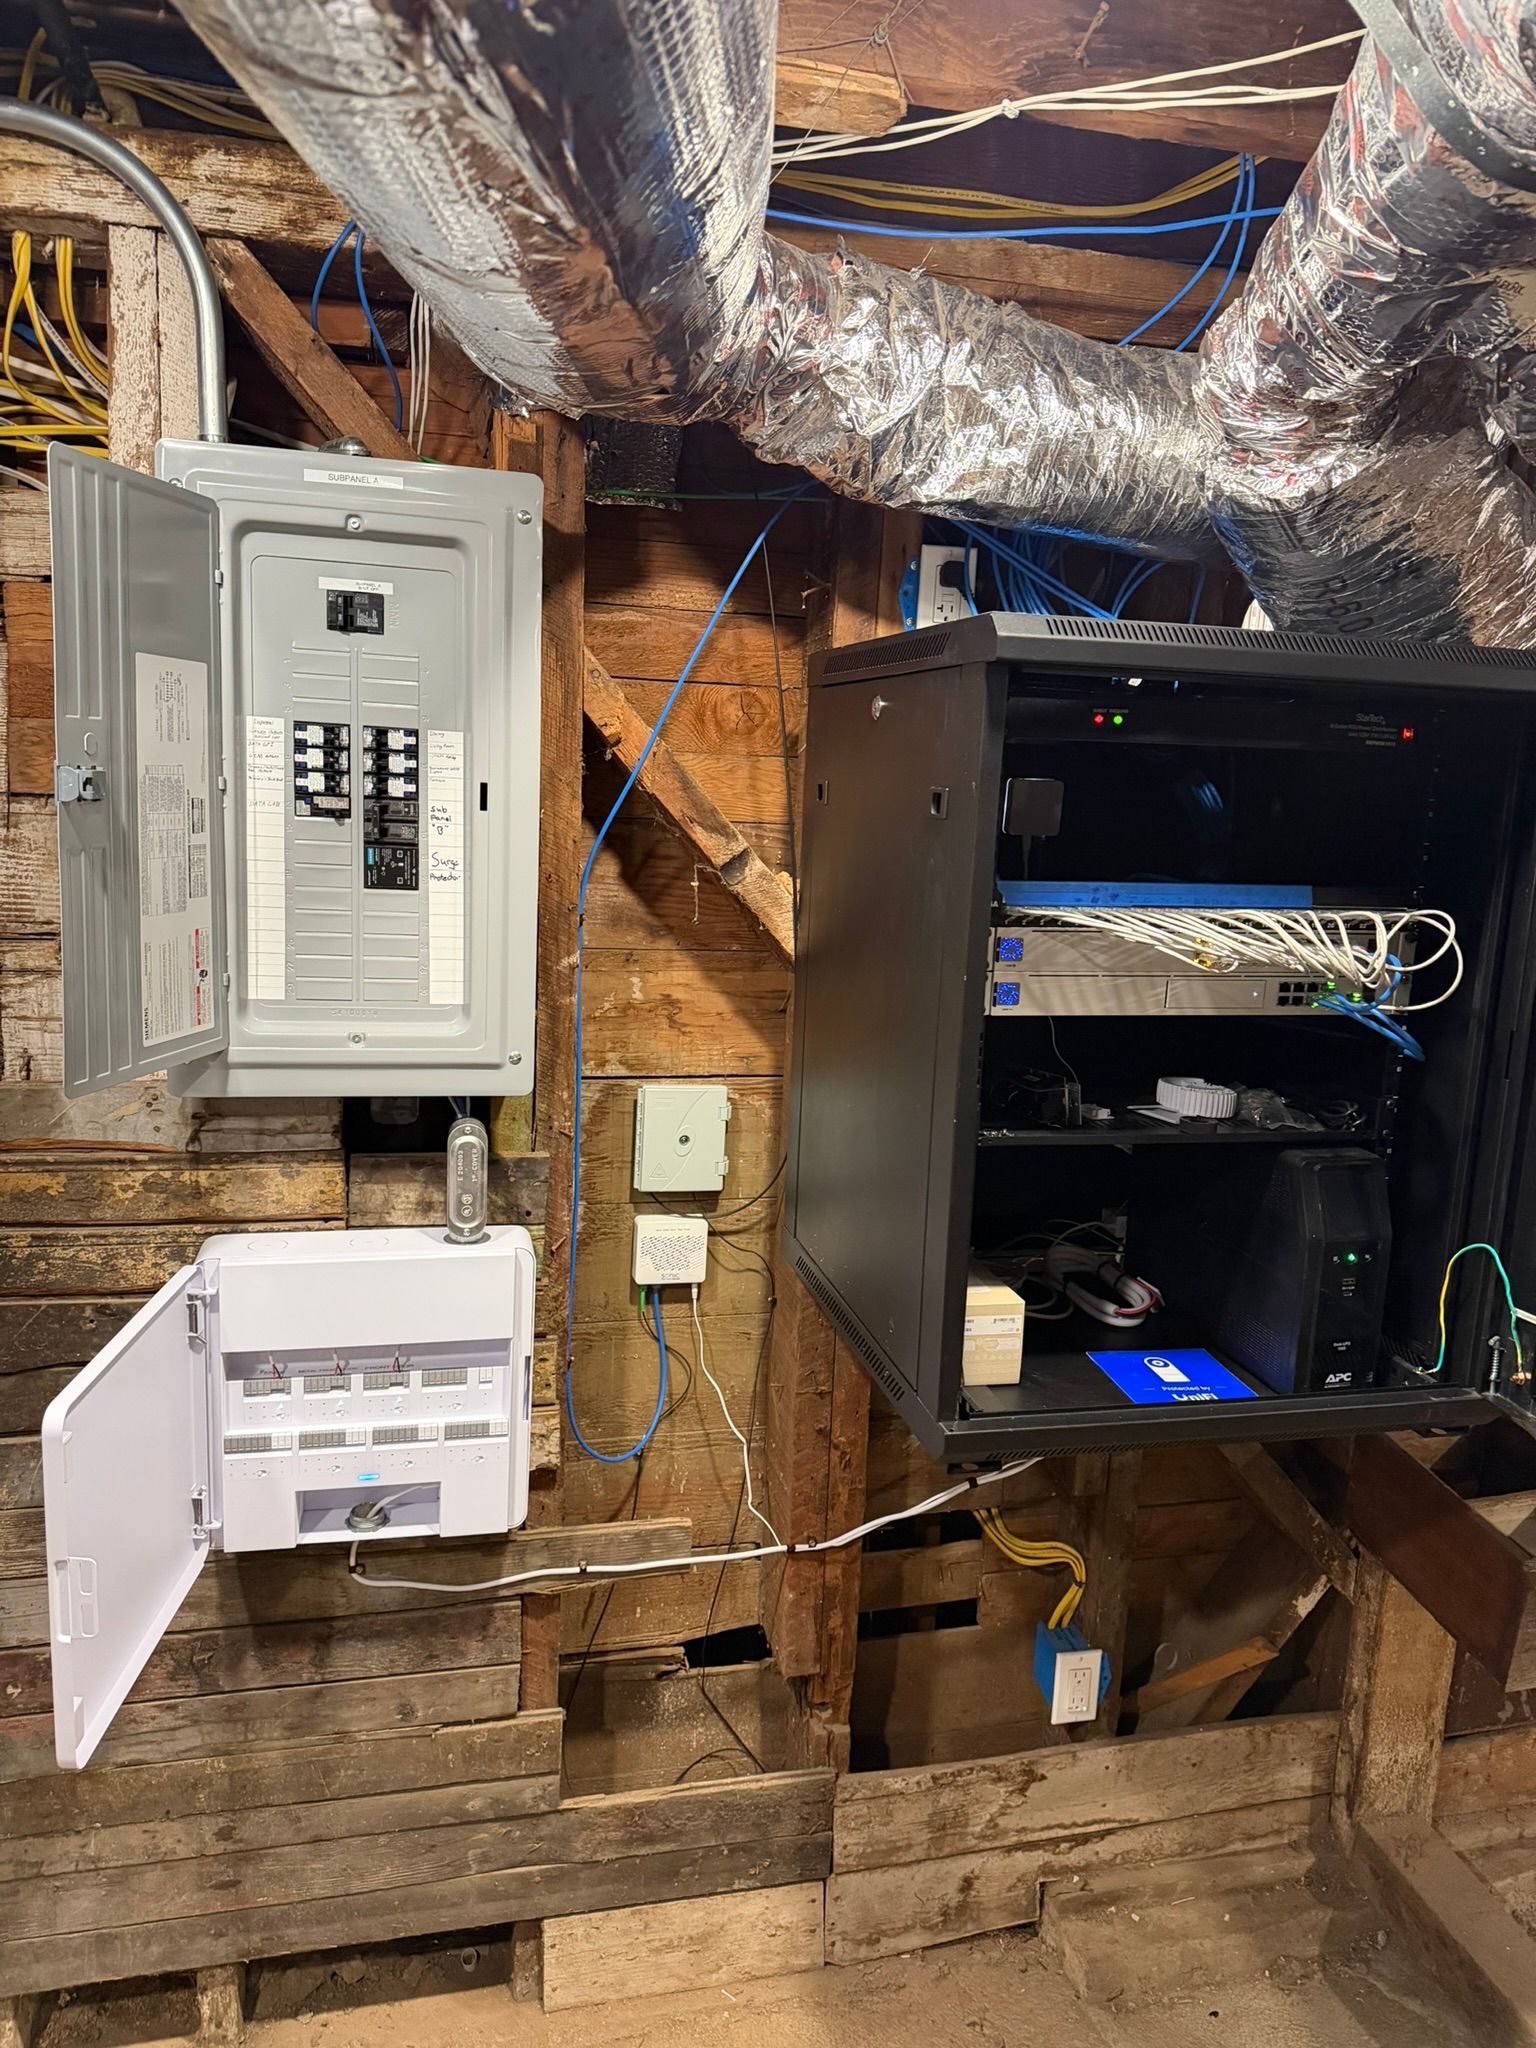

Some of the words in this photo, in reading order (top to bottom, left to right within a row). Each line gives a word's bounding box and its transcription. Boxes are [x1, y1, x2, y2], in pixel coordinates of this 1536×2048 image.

[328, 473, 372, 484] SUBPANEL
[431, 852, 460, 870] Surge
[1325, 1372, 1352, 1383] APC
